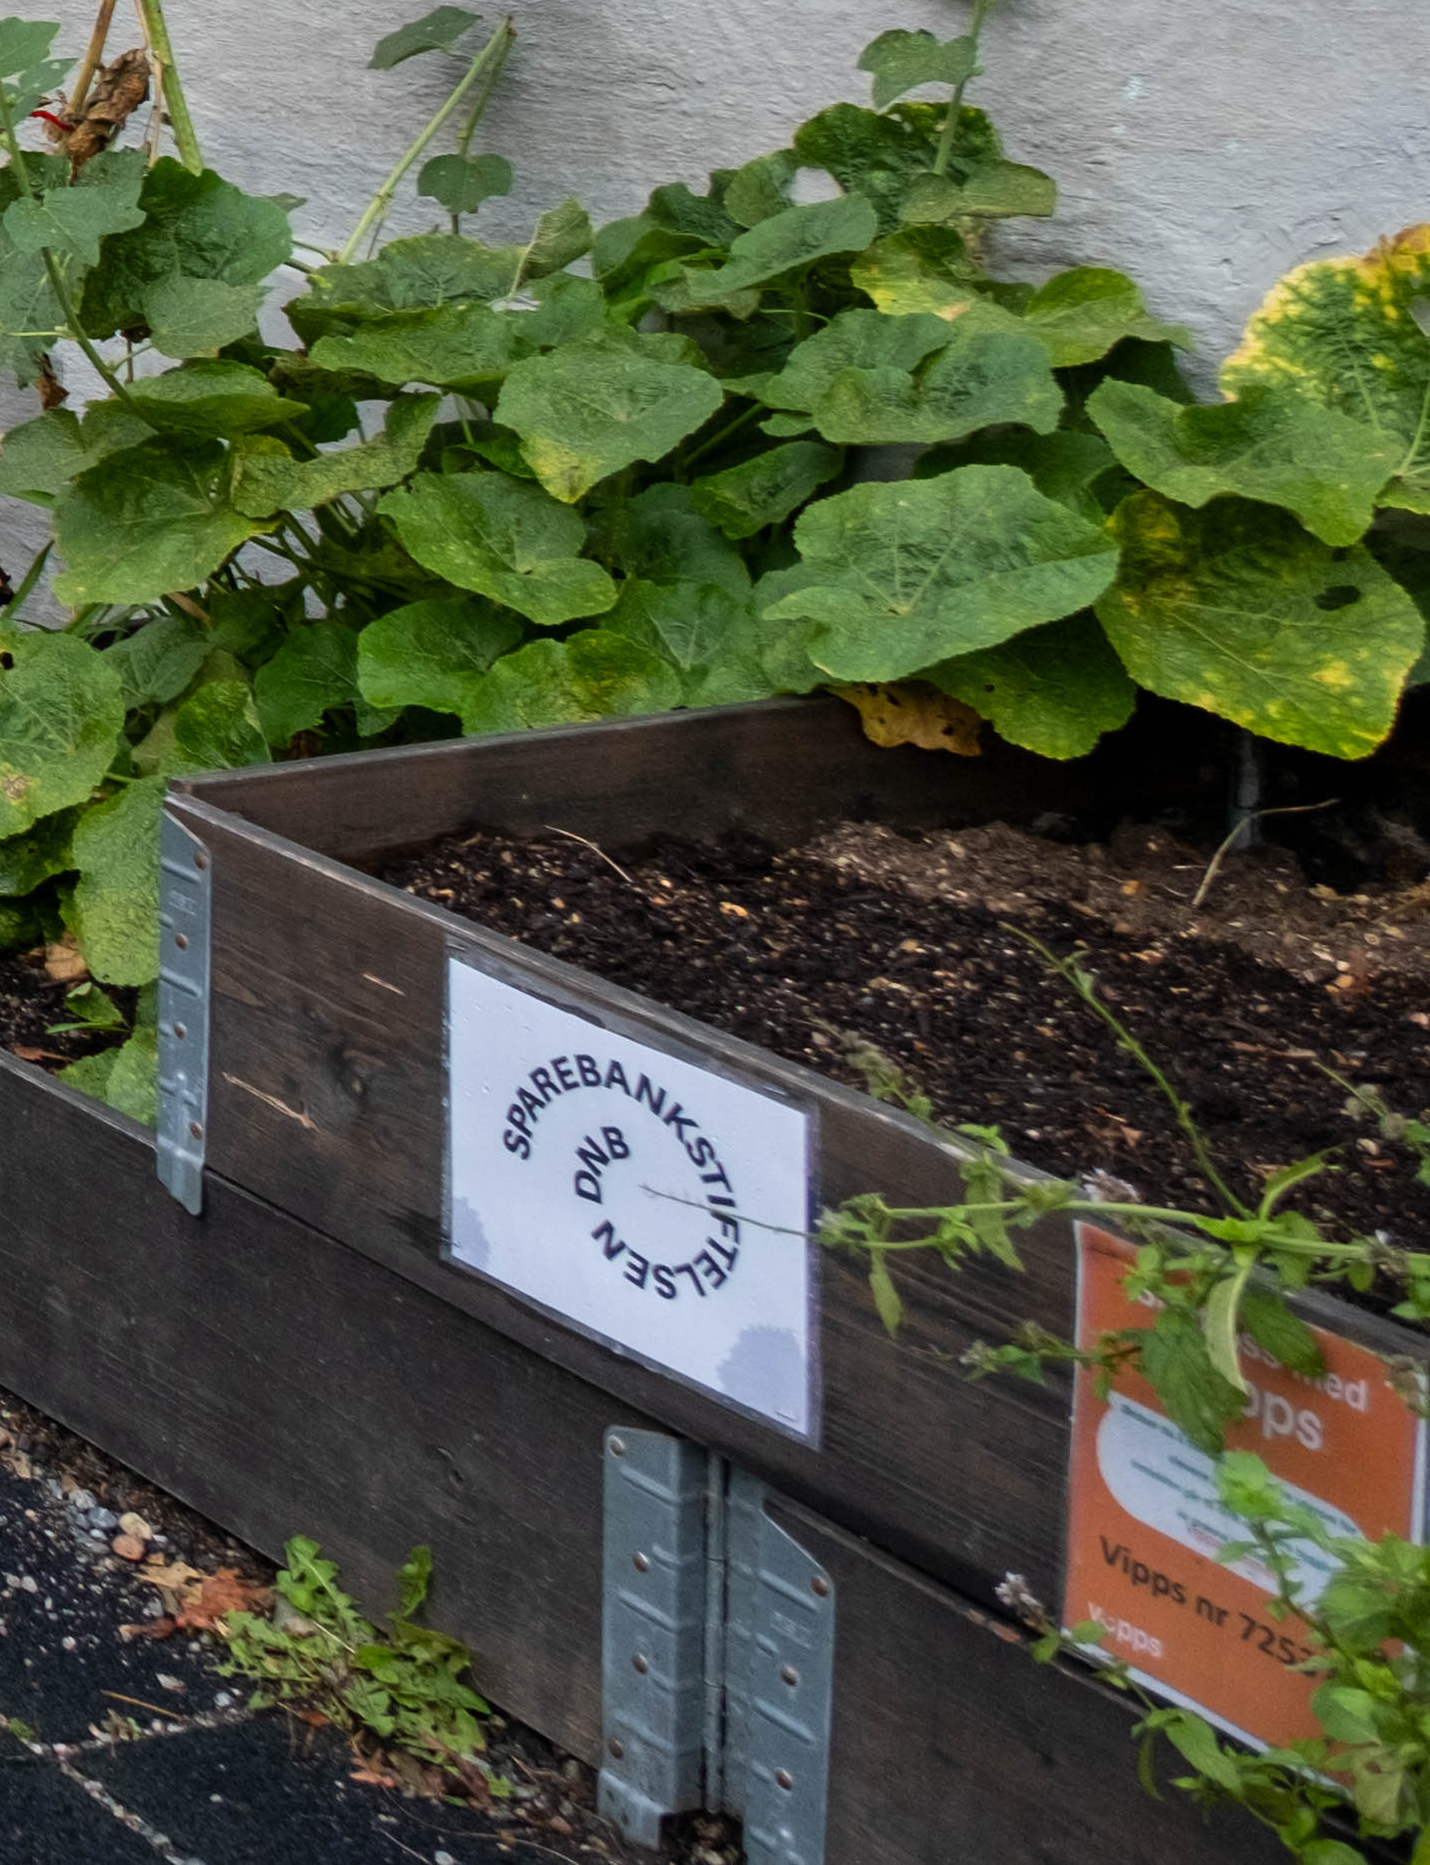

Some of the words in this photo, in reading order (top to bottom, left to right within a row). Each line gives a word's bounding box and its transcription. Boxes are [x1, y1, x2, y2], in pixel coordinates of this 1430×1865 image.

[575, 1125, 631, 1204] DNB
[1099, 1534, 1187, 1606] Vipps
[1195, 1594, 1229, 1627] nr
